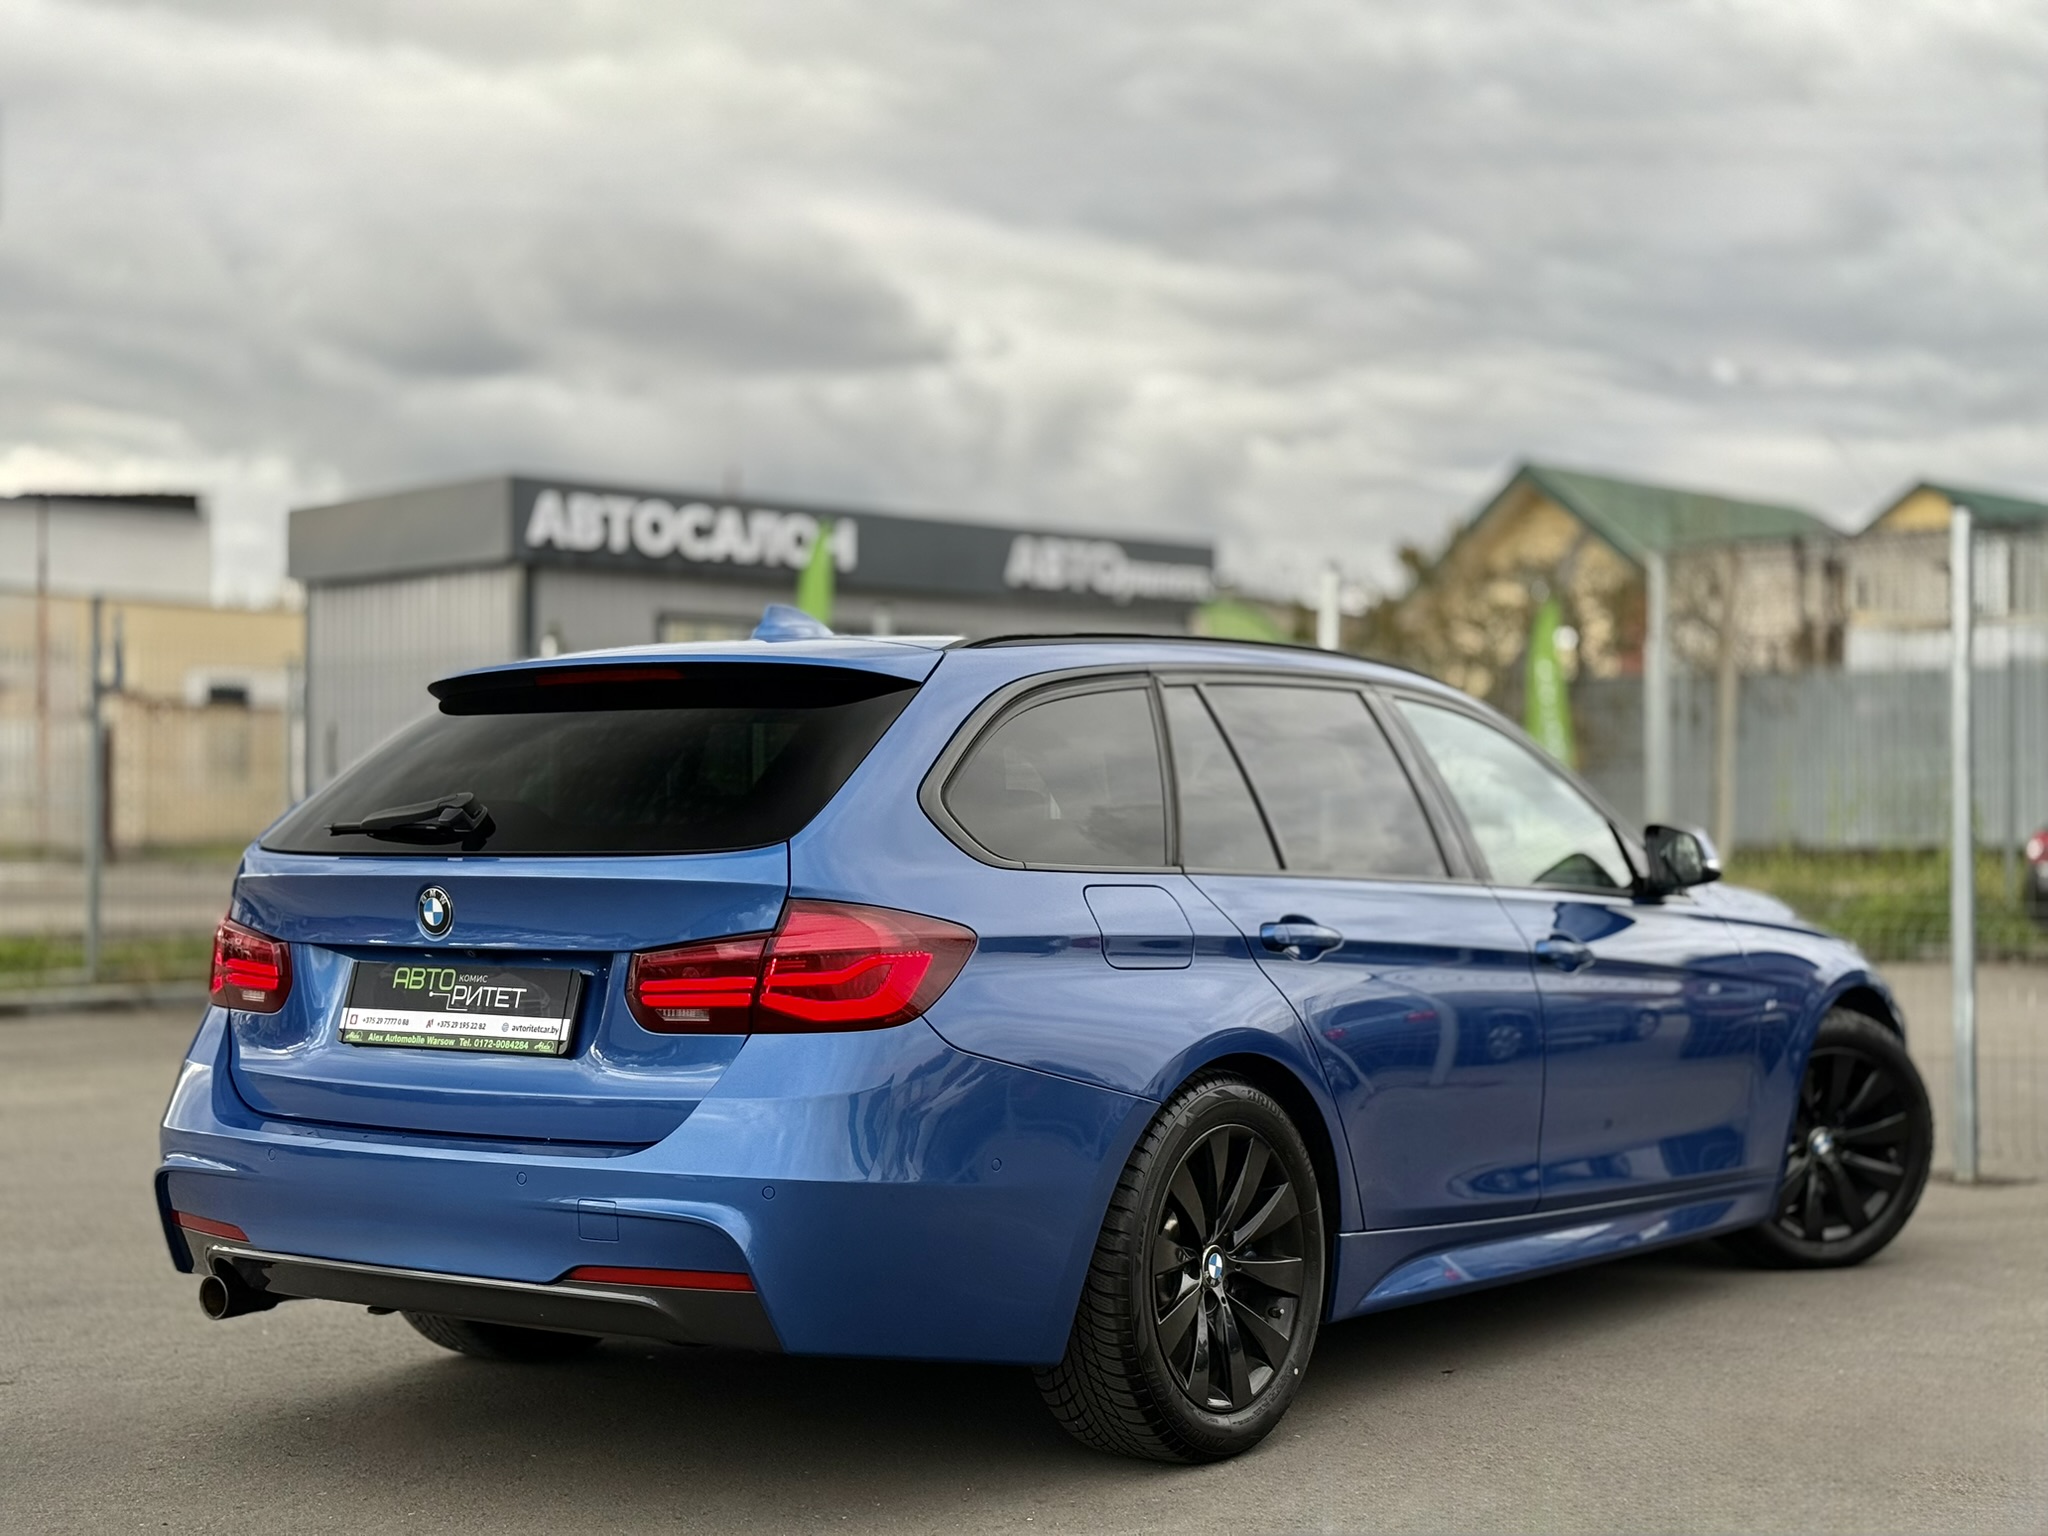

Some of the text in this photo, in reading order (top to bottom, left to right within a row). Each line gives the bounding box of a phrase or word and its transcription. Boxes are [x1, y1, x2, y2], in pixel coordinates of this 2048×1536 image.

[526, 489, 858, 573] АВТОСАЛОН
[393, 967, 456, 990] АВТО
[451, 985, 527, 1009] РИТЕТ
[437, 1020, 451, 1028] +375
[511, 1024, 559, 1035] avtoritetcar.by
[368, 1032, 384, 1042] Alex
[384, 1033, 425, 1044] Automobile
[426, 1035, 456, 1046] Warsow
[459, 1037, 472, 1047] Tel.
